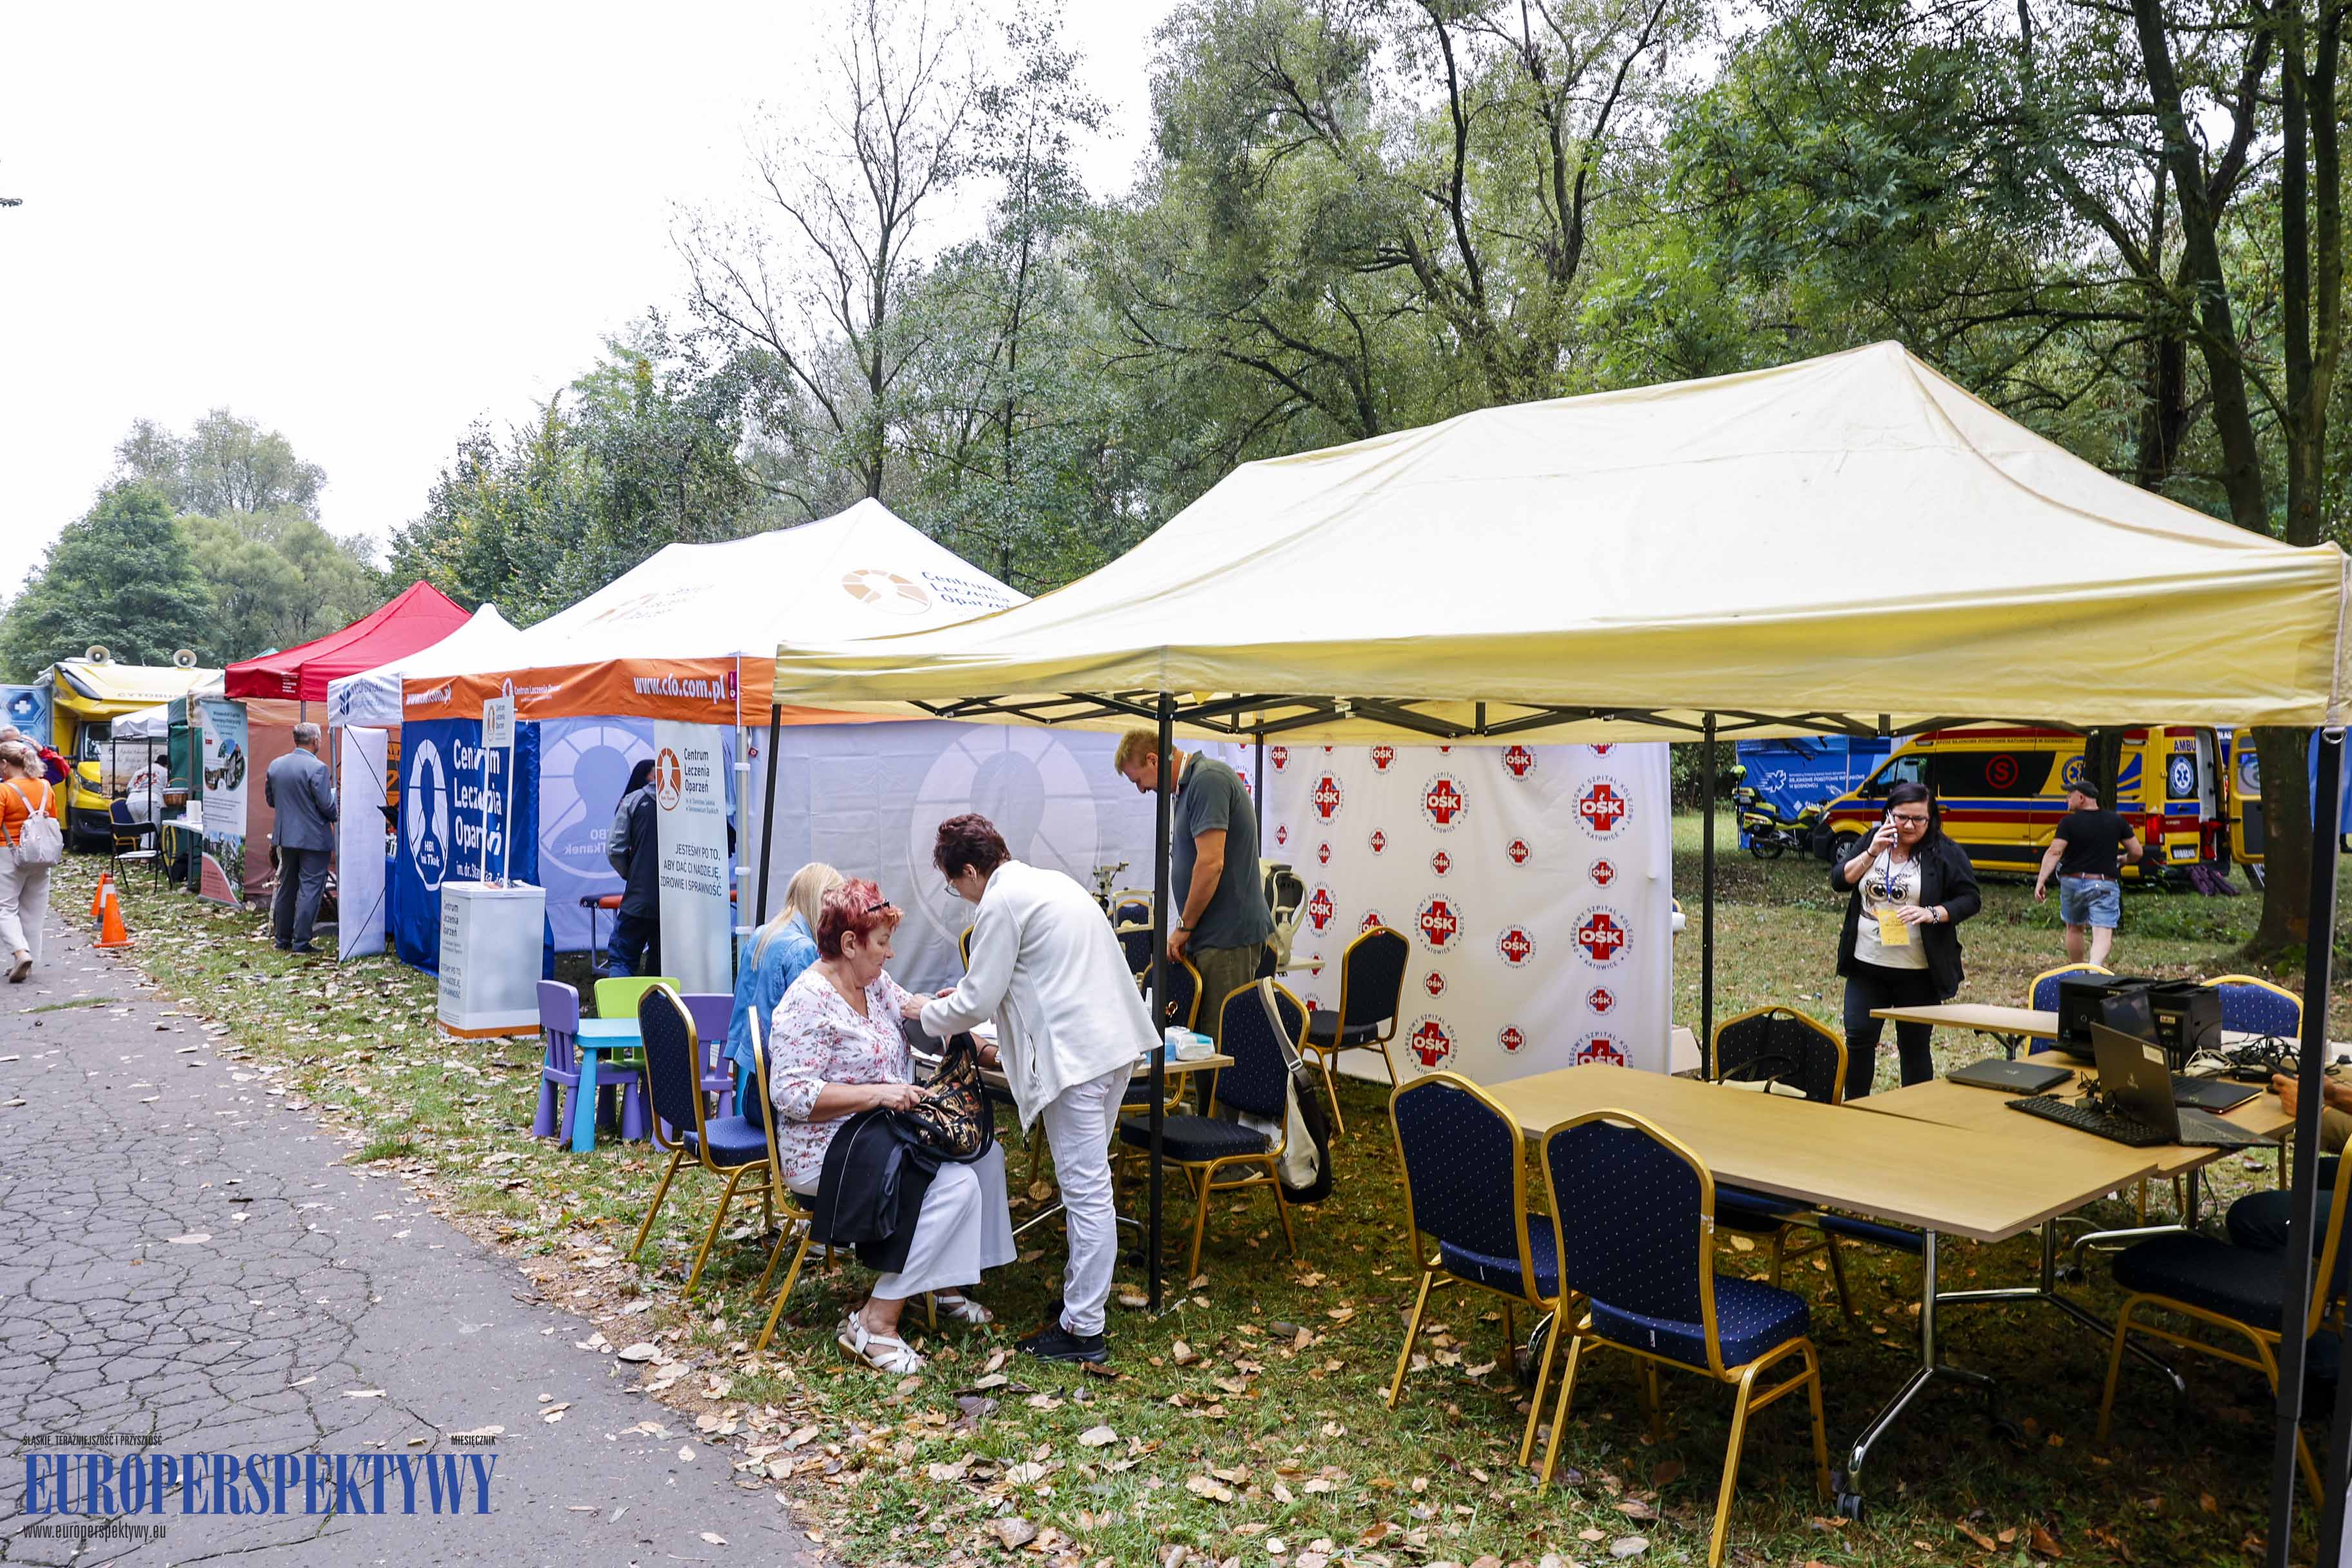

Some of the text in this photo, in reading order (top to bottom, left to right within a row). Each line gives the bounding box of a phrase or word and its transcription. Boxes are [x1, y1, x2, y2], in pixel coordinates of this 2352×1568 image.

[684, 748, 709, 761] Centrum
[1373, 750, 1392, 758] OSK
[1506, 755, 1530, 765] OSK
[685, 763, 710, 777] Leczenia
[1994, 761, 2010, 781] S
[1587, 774, 1618, 784] SZPITAL
[685, 779, 709, 794] Oparzeń
[1315, 792, 1338, 803] OSK
[1428, 795, 1459, 808] OSK
[1582, 800, 1622, 814] OSK
[1585, 831, 1620, 841] KATOWICE
[675, 842, 720, 861] JESTEŚMY PO TO,
[664, 859, 721, 881] ABY DAĆ CI NADZIEJĘ,
[660, 876, 684, 890] ZDROWIE
[688, 880, 721, 896] SPRAWNOŚĆ
[1310, 903, 1331, 916] OSK
[1587, 905, 1616, 914] SZPITAL
[1422, 916, 1454, 930] OSK
[1580, 930, 1620, 944] OSK
[1424, 944, 1451, 955] KATOWICE
[1502, 941, 1528, 952] OSK
[1584, 960, 1618, 970] KATOWICE
[1427, 979, 1443, 988] OSK
[1585, 1032, 1616, 1041] SZPITAL
[1414, 1035, 1446, 1052] OSK
